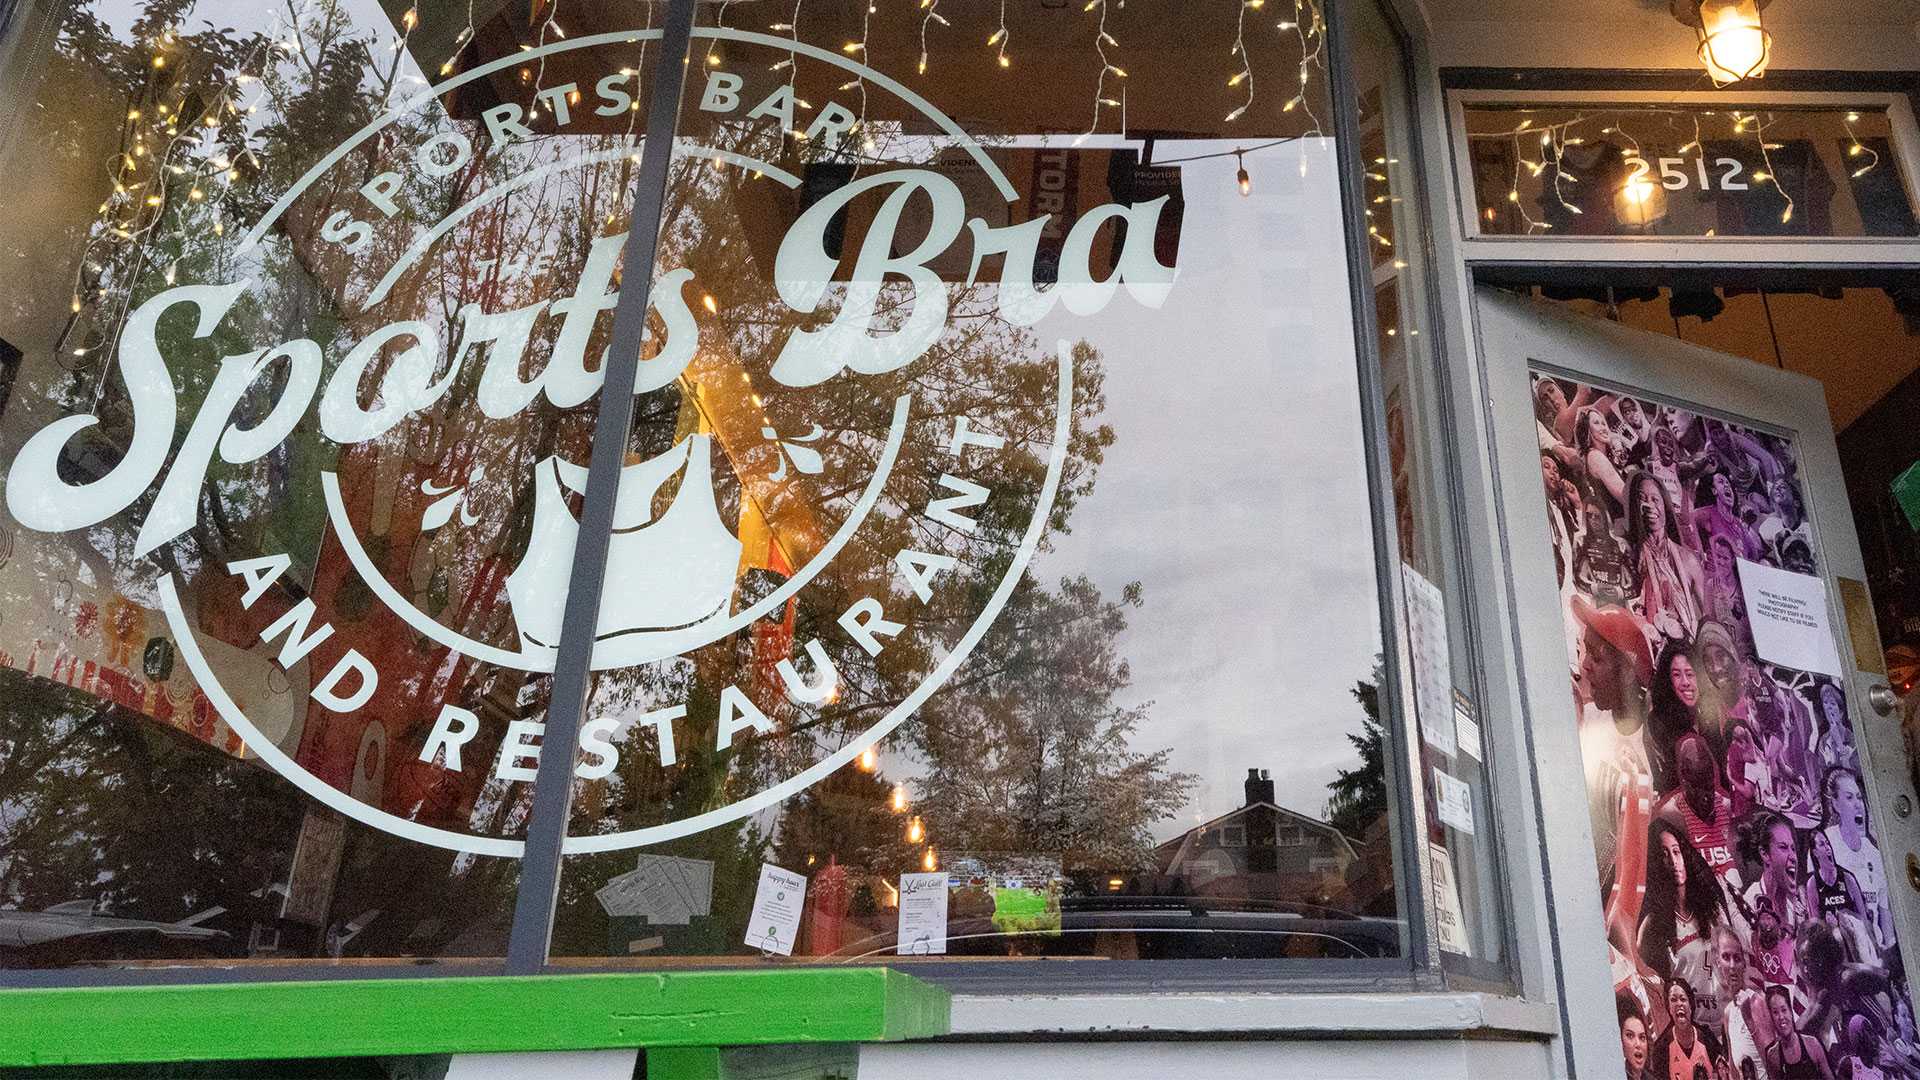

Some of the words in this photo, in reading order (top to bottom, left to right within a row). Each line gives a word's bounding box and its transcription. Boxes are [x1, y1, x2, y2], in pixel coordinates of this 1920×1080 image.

[320, 74, 633, 253] SPORTS
[699, 71, 856, 150] BAR
[1038, 130, 1070, 240] TORM
[1623, 157, 1749, 190] 2512
[473, 252, 556, 285] THE
[6, 230, 699, 560] Sports
[768, 168, 1180, 388] Bra
[227, 552, 379, 713] AND
[418, 414, 1007, 782] RESTAURANT
[1824, 895, 1846, 906] ACES
